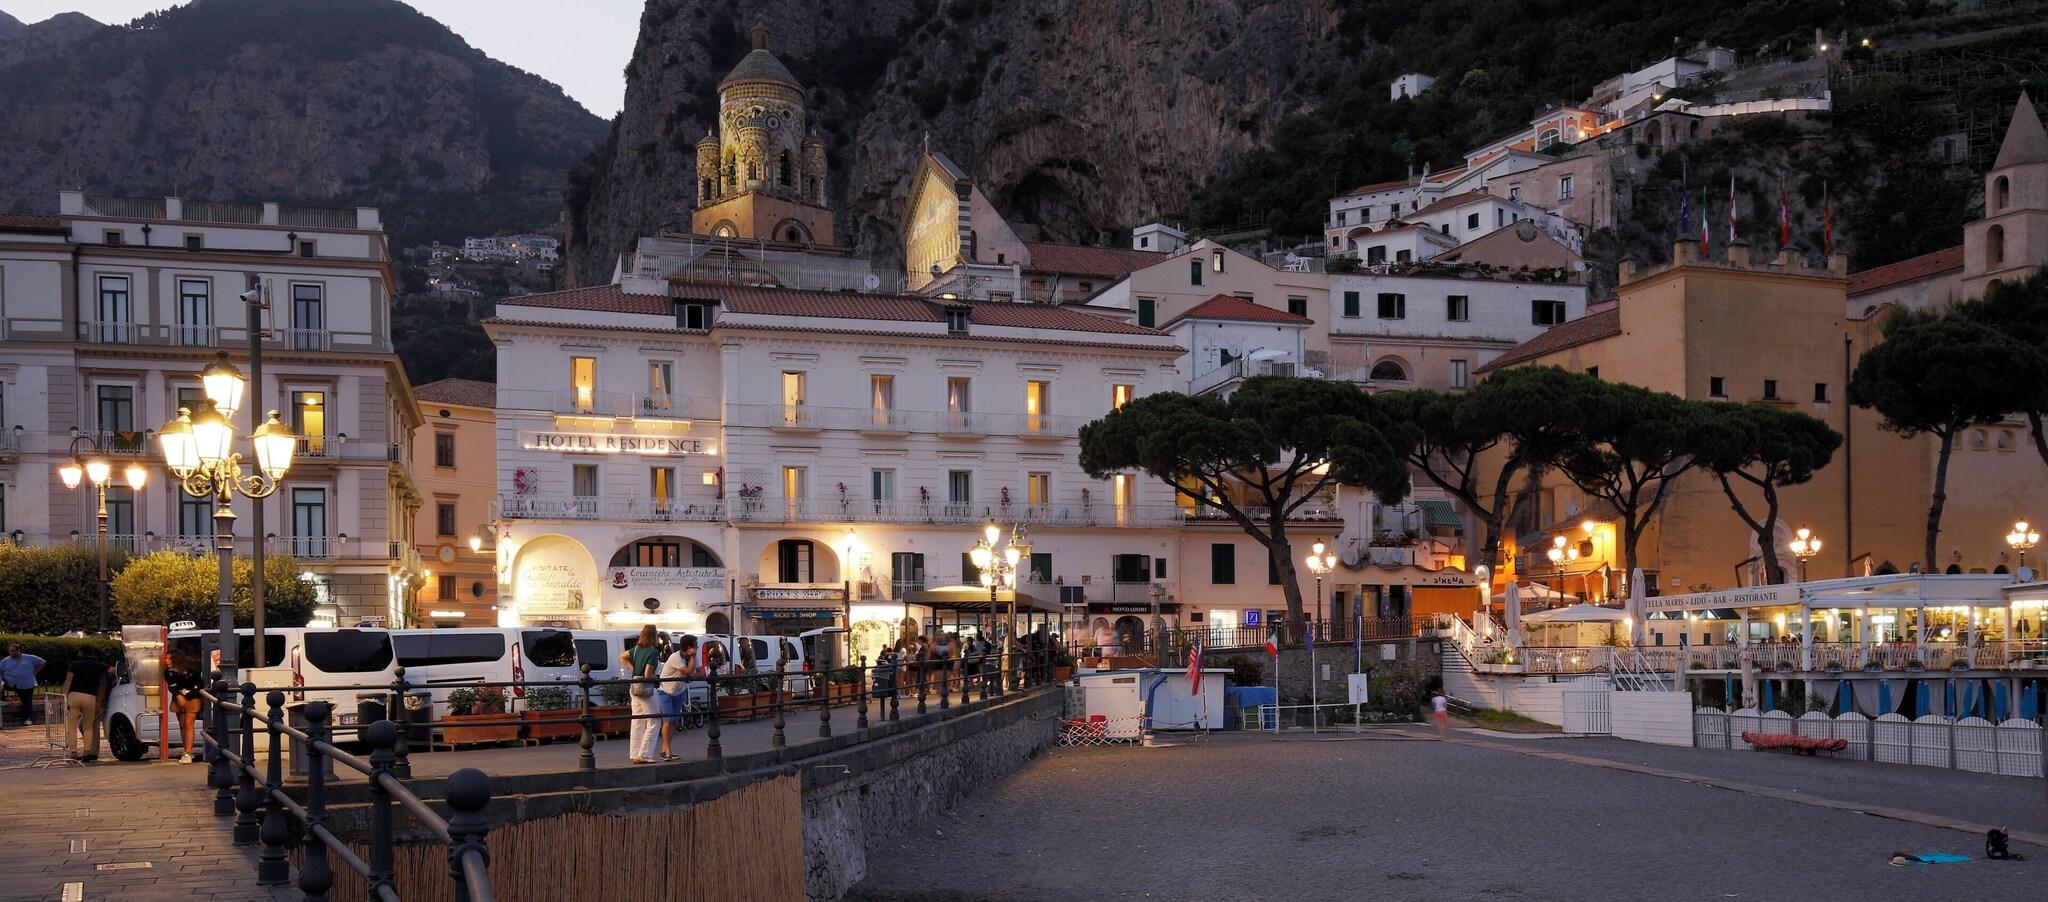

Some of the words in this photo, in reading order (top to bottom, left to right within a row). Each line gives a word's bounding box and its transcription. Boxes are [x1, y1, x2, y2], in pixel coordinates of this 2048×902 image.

[535, 435, 594, 448] HOTEL
[606, 437, 702, 453] RESIDENCE
[630, 568, 671, 578] Ceramiche
[1644, 600, 1663, 609] TELLA
[1665, 599, 1685, 607] MARIS
[1690, 597, 1707, 606] LIDO
[1713, 596, 1727, 604] BAR
[1734, 592, 1777, 603] RISTORANTE
